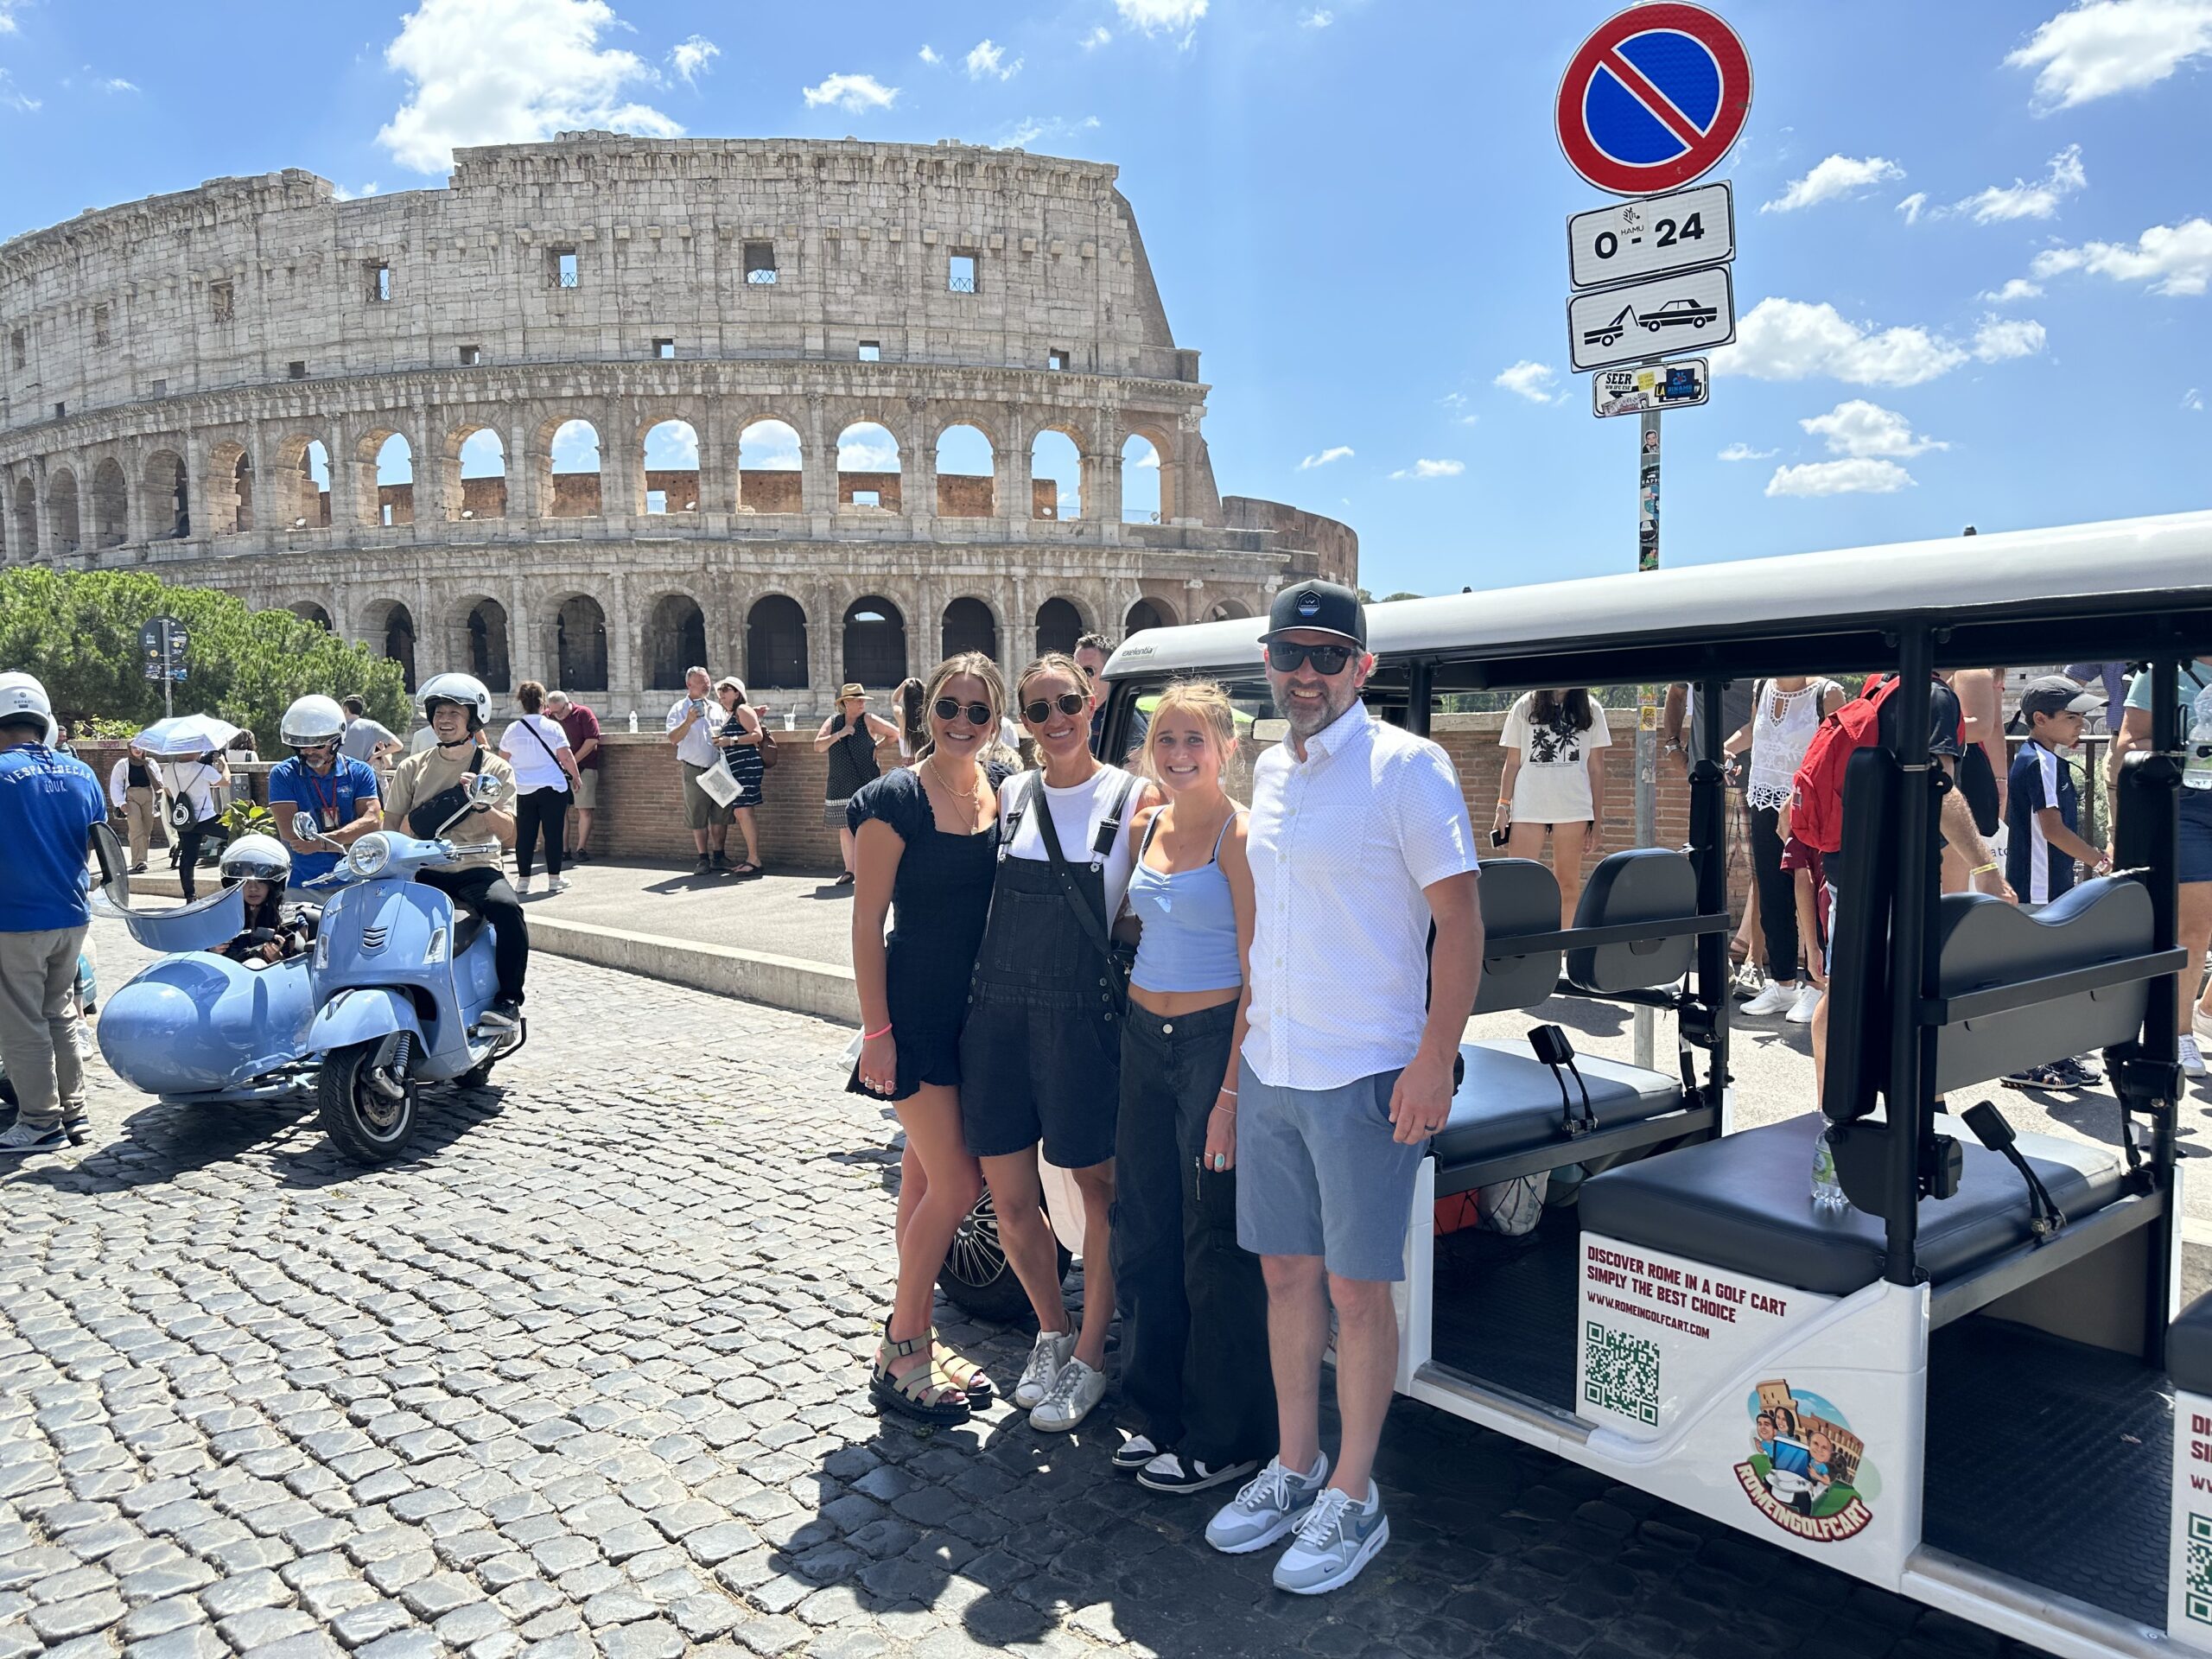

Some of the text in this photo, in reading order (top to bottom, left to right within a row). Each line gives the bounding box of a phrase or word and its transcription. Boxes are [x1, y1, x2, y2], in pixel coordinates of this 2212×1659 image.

[1620, 226, 1644, 236] HAMU
[1655, 212, 1705, 248] 24
[1606, 372, 1632, 385] SEER
[1586, 1265, 1737, 1324] SIMPLY THE BEST CHOICE
[1587, 1245, 1787, 1318] DISCOVER ROME IN A GOLF CART
[1586, 1290, 1710, 1339] WWW.ROMEINGOLFCART.COM
[2191, 1414, 2212, 1437] DI
[2190, 1440, 2212, 1463] SI
[1737, 1464, 1870, 1539] ROMEINGOLFCART
